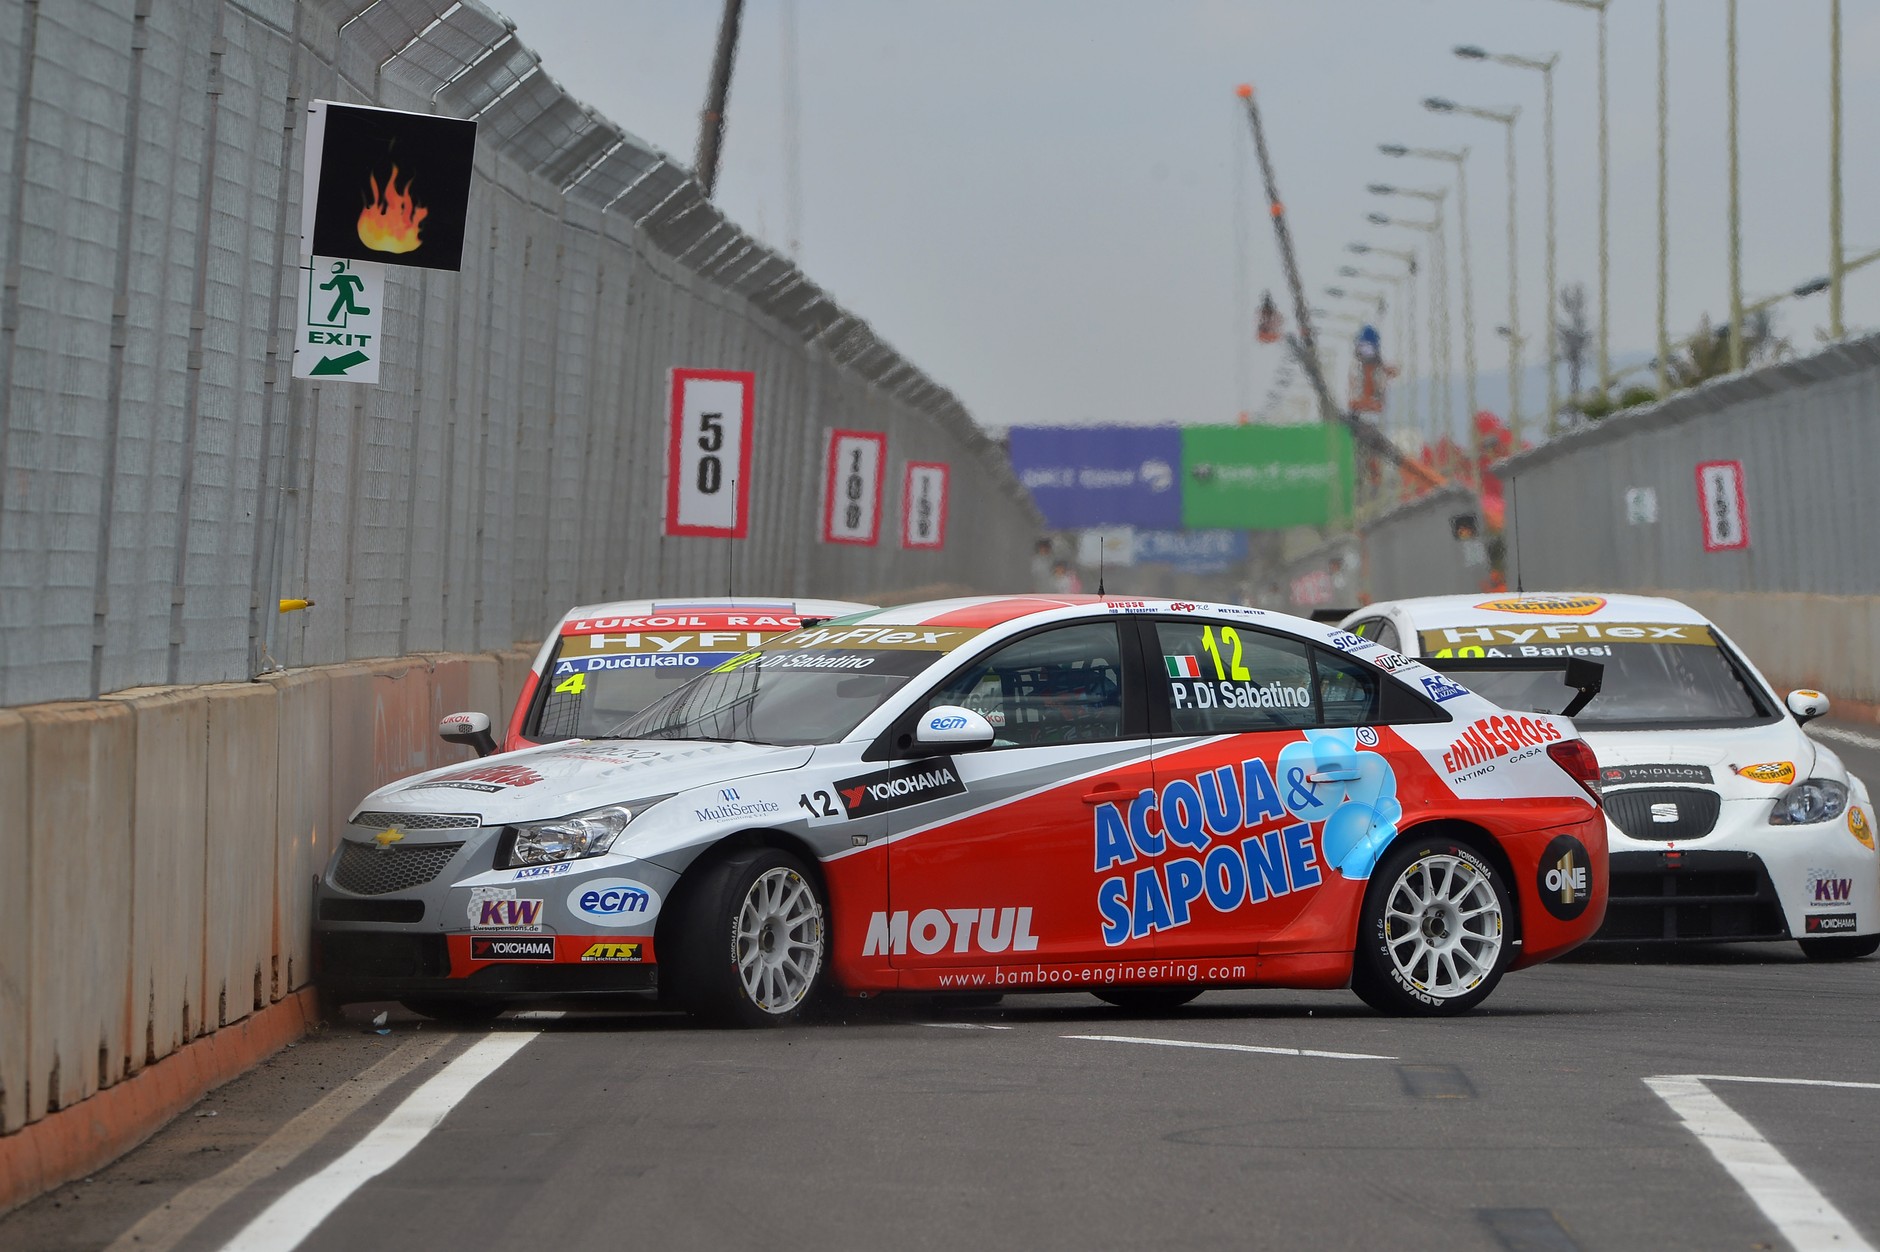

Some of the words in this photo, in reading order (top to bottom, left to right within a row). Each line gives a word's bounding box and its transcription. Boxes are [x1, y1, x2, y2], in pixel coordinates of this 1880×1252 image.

[308, 331, 372, 347] EXIT
[697, 411, 723, 494] 50
[574, 616, 707, 631] LUKOIL
[727, 616, 803, 627] RAC
[1442, 624, 1688, 643] HyFlex
[590, 632, 762, 652] HyFl
[781, 627, 956, 649] HyFlex
[555, 660, 580, 674] A.
[586, 653, 699, 671] Dudukalo
[781, 654, 875, 669] Sabatino
[1201, 625, 1251, 681] 12
[1519, 645, 1612, 658] Barlesi
[554, 673, 587, 695] 4
[1171, 682, 1192, 709] P.
[1193, 682, 1218, 709] Di
[1219, 680, 1310, 709] Sabatino
[930, 715, 968, 731] ecm
[1442, 714, 1562, 774] EMMEGROSS
[1454, 764, 1496, 784] INTIMO
[1509, 747, 1542, 764] CASA
[1629, 767, 1704, 776] RAIDILLON
[866, 768, 956, 801] YOKOHAMA
[695, 799, 779, 822] MultiService
[798, 789, 839, 818] 12
[1094, 757, 1287, 873] ACQUA
[1457, 849, 1492, 879] YOKOHAMA
[1097, 823, 1322, 947] SAPONE
[1545, 867, 1587, 892] ONE
[1815, 878, 1852, 900] KW
[579, 887, 650, 913] ecm
[479, 900, 543, 926] KW
[1820, 918, 1856, 928] YOKOHAMA
[861, 906, 1039, 957] MOTUL
[491, 942, 552, 954] YOKOHAMA
[582, 943, 638, 957] ATS
[938, 960, 1247, 987] www.bamboo-engineering.com
[1390, 967, 1445, 1007] ADVAN
